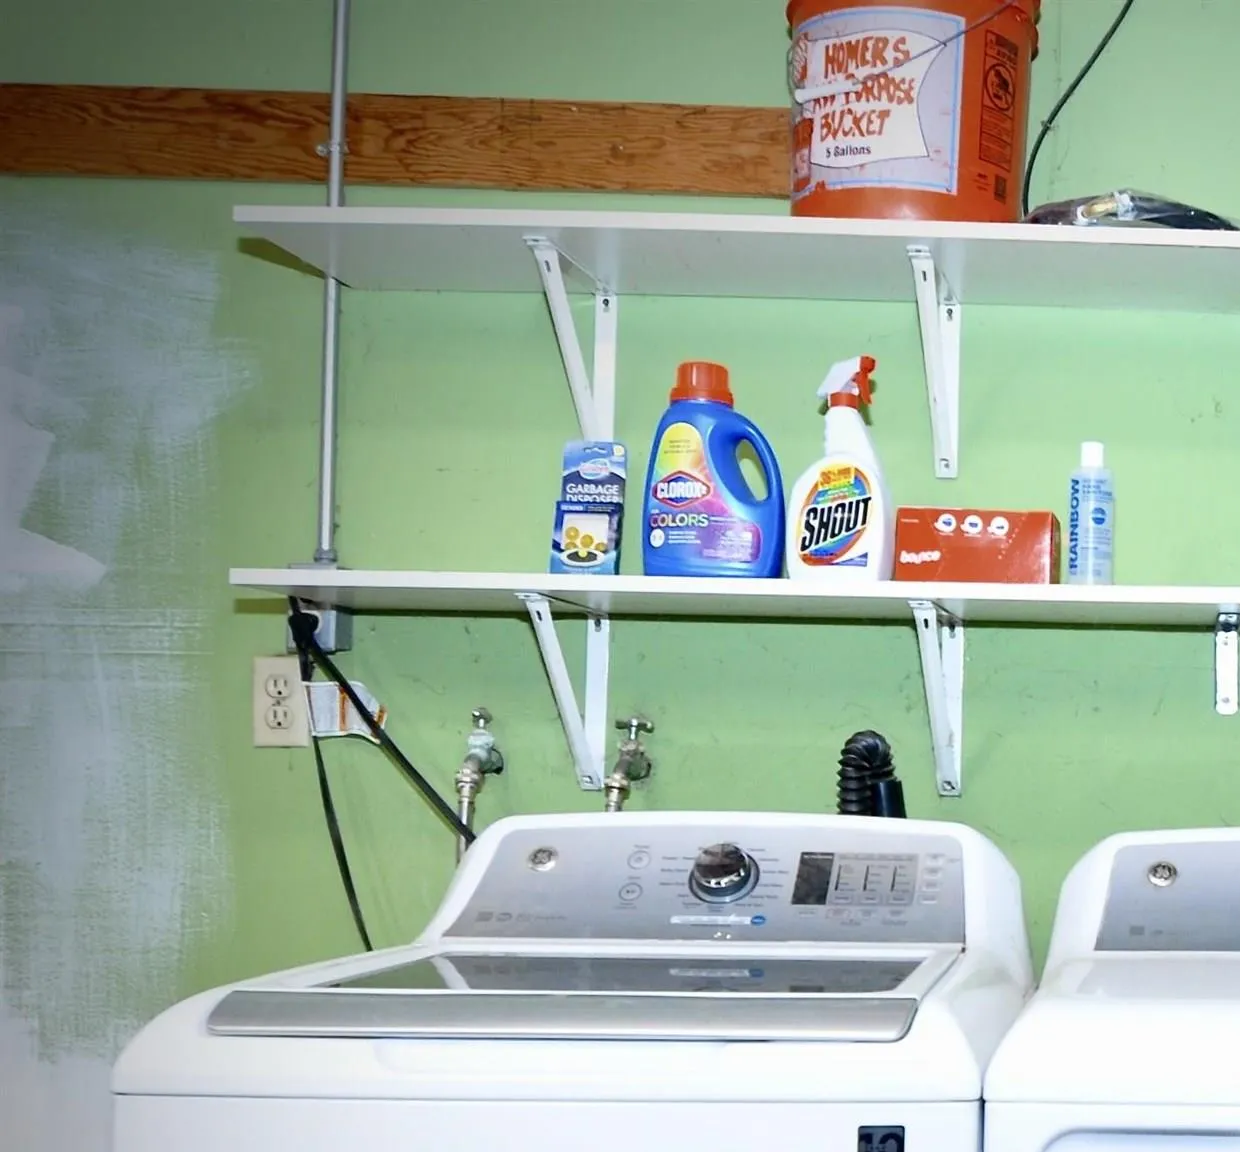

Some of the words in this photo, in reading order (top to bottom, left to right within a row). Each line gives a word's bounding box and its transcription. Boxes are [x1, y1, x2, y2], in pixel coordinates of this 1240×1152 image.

[820, 108, 891, 142] BUCKET
[826, 147, 832, 158] 5
[833, 144, 872, 157] Gallons
[566, 483, 619, 495] GARBAGE
[650, 513, 709, 528] COLORS
[800, 496, 872, 552] SHOUT
[1069, 479, 1079, 569] RAINBOW
